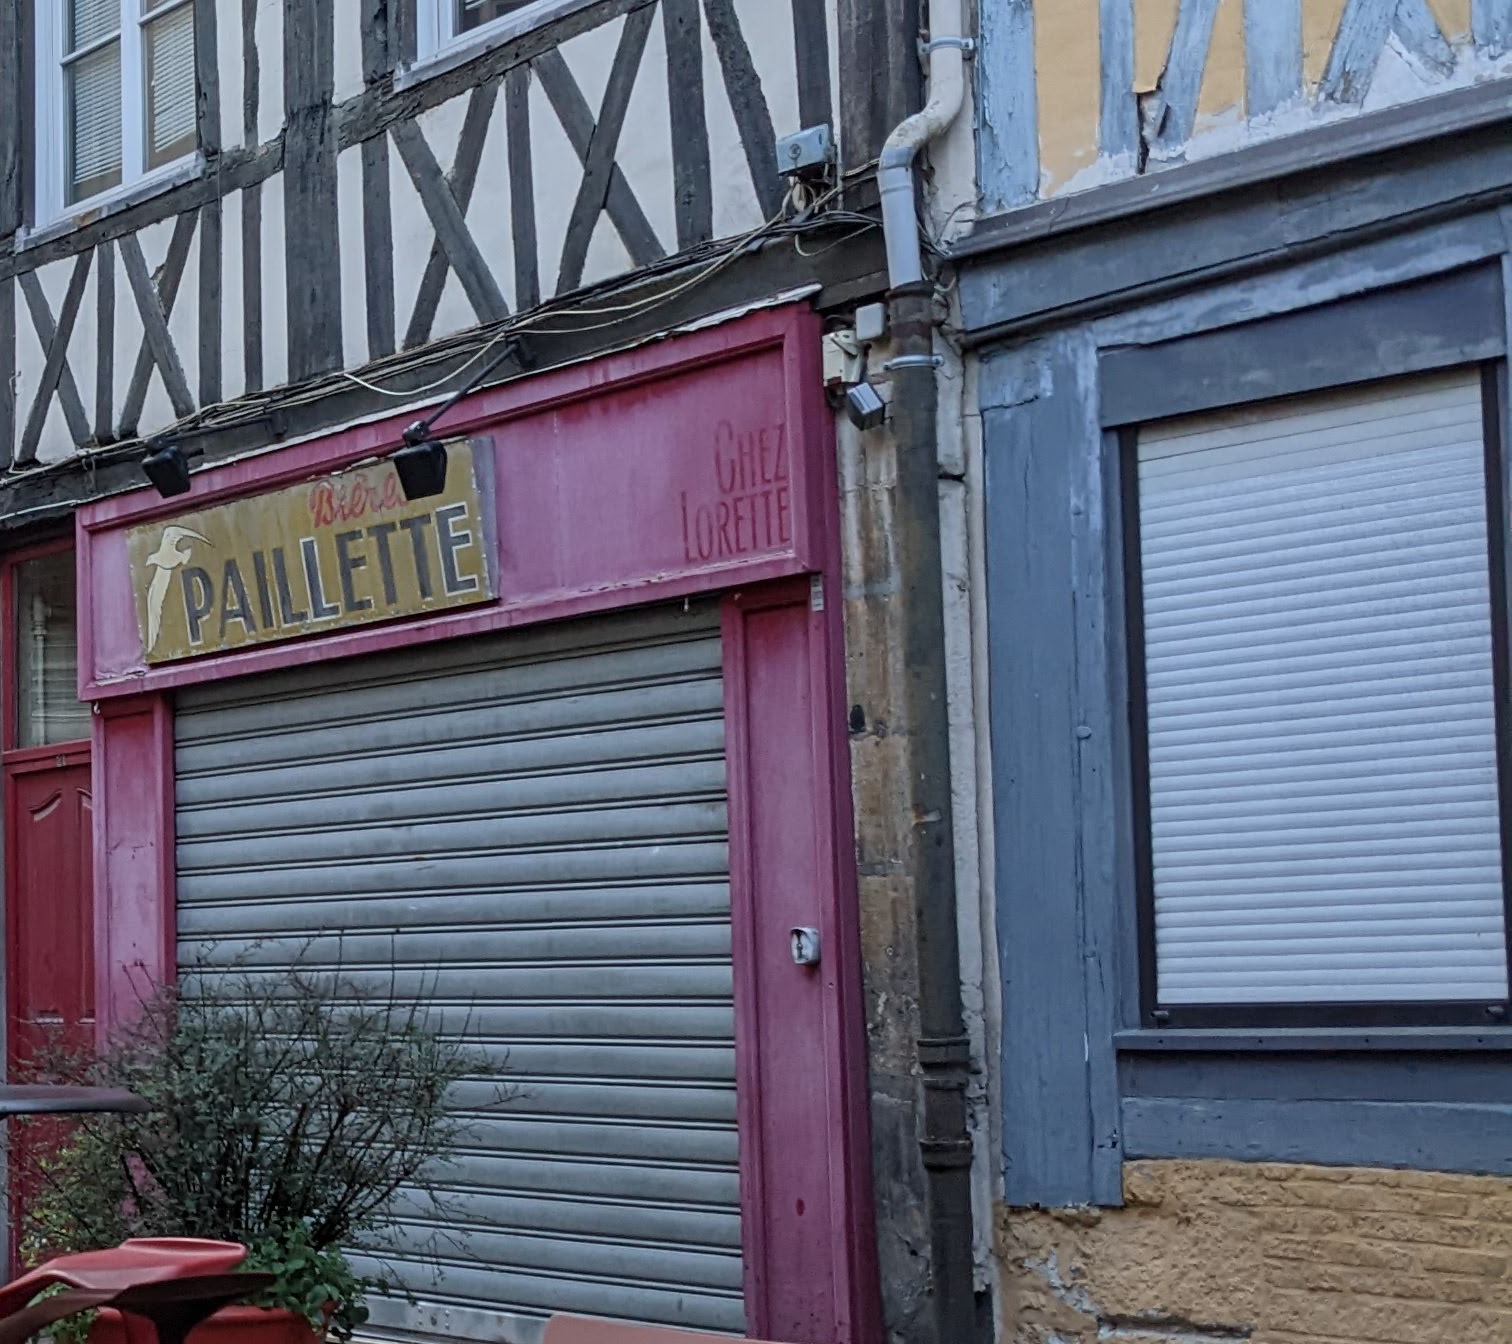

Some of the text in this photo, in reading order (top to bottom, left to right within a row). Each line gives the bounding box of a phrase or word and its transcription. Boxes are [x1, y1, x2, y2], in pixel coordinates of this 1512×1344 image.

[715, 419, 786, 494] CHEZ
[681, 486, 790, 563] LORETTE
[181, 501, 479, 646] PAILLETTE
